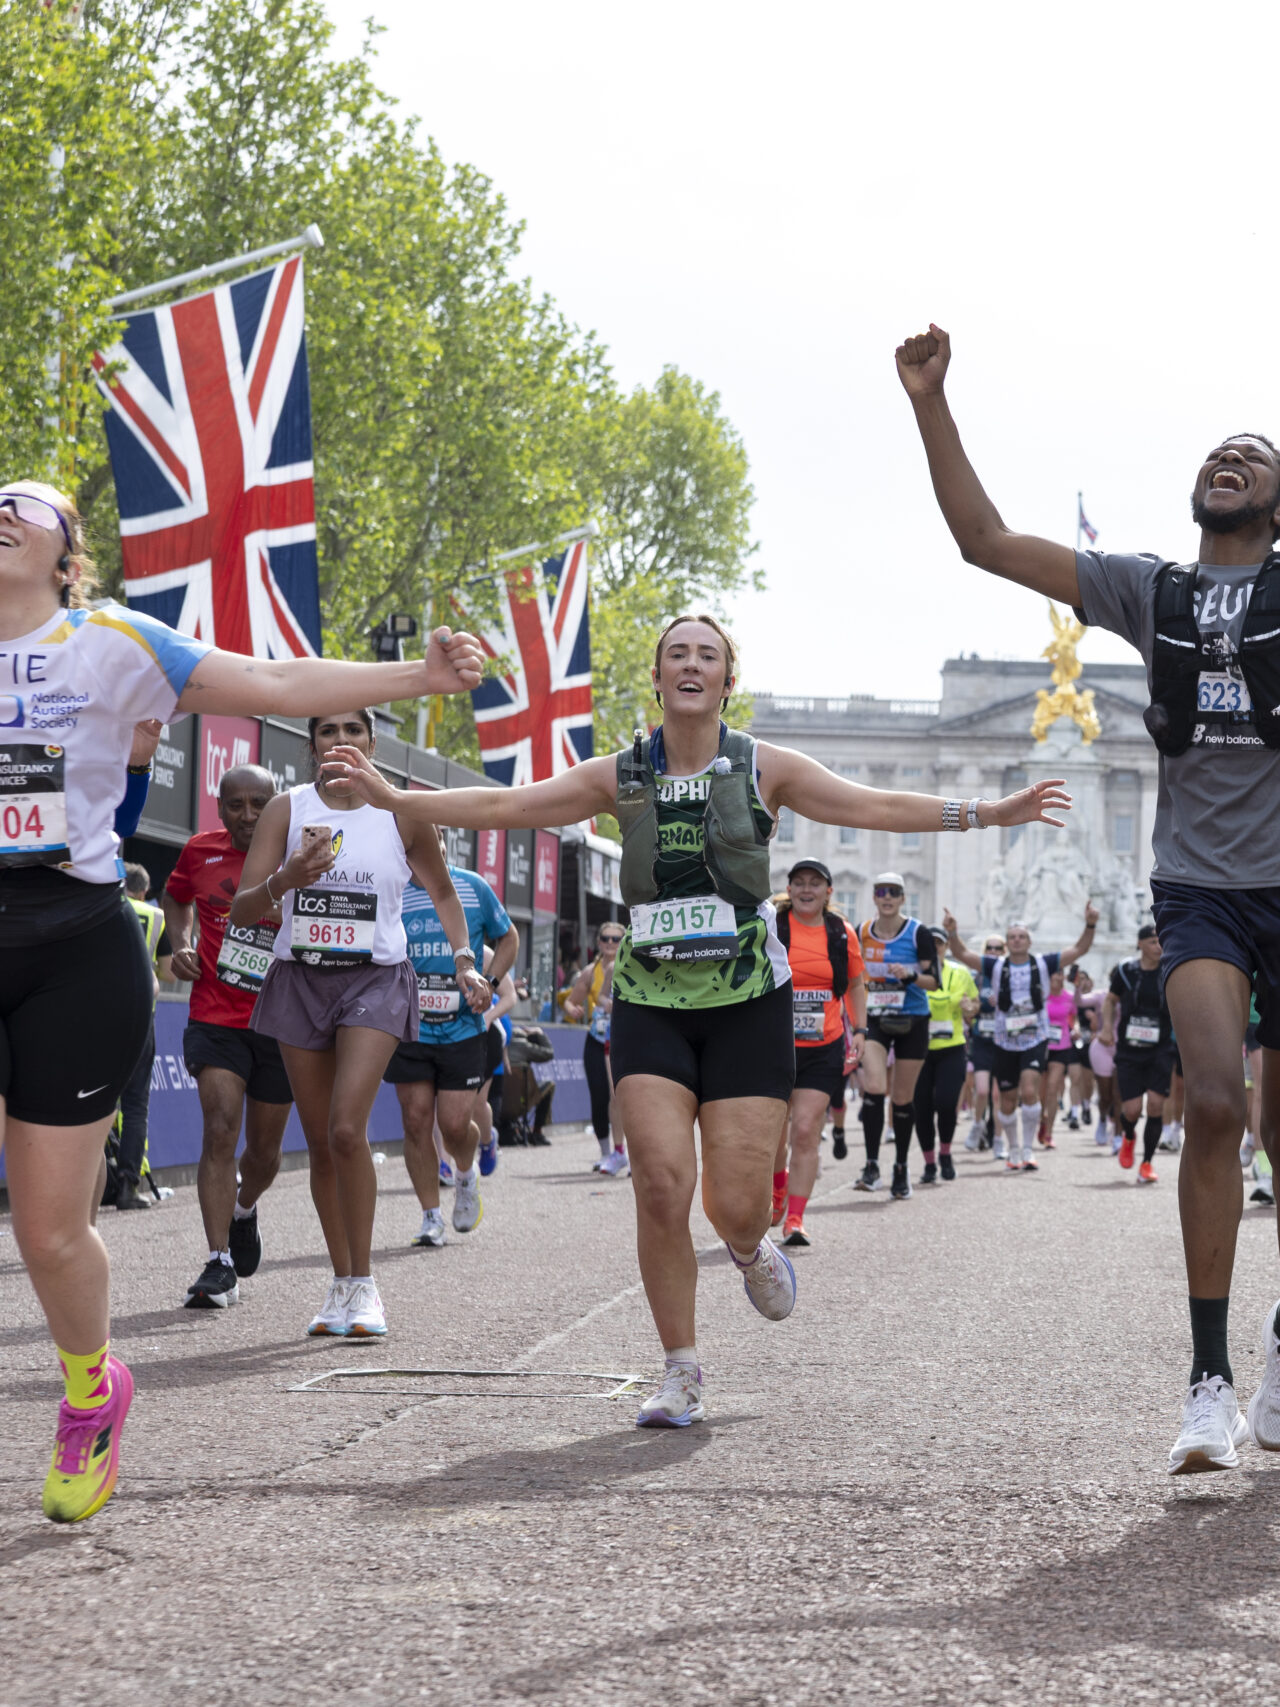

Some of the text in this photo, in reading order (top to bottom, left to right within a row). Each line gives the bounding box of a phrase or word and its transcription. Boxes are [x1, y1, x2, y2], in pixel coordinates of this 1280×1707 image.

[31, 692, 89, 703] National
[1197, 681, 1254, 711] 623
[31, 705, 83, 715] Autistic
[31, 717, 78, 728] Society
[1205, 735, 1225, 744] new
[0, 764, 55, 774] SULTANCY
[0, 804, 44, 840] 04
[355, 871, 374, 886] UK
[298, 893, 327, 913] tcs
[330, 895, 349, 903] TATA
[329, 902, 372, 911] CONSULTANCY
[309, 923, 355, 945] 9613
[408, 941, 453, 958] JEREM
[675, 951, 693, 960] new
[694, 948, 730, 958] balance
[229, 947, 269, 973] 7569
[419, 995, 451, 1009] 5937
[794, 1016, 816, 1029] 232
